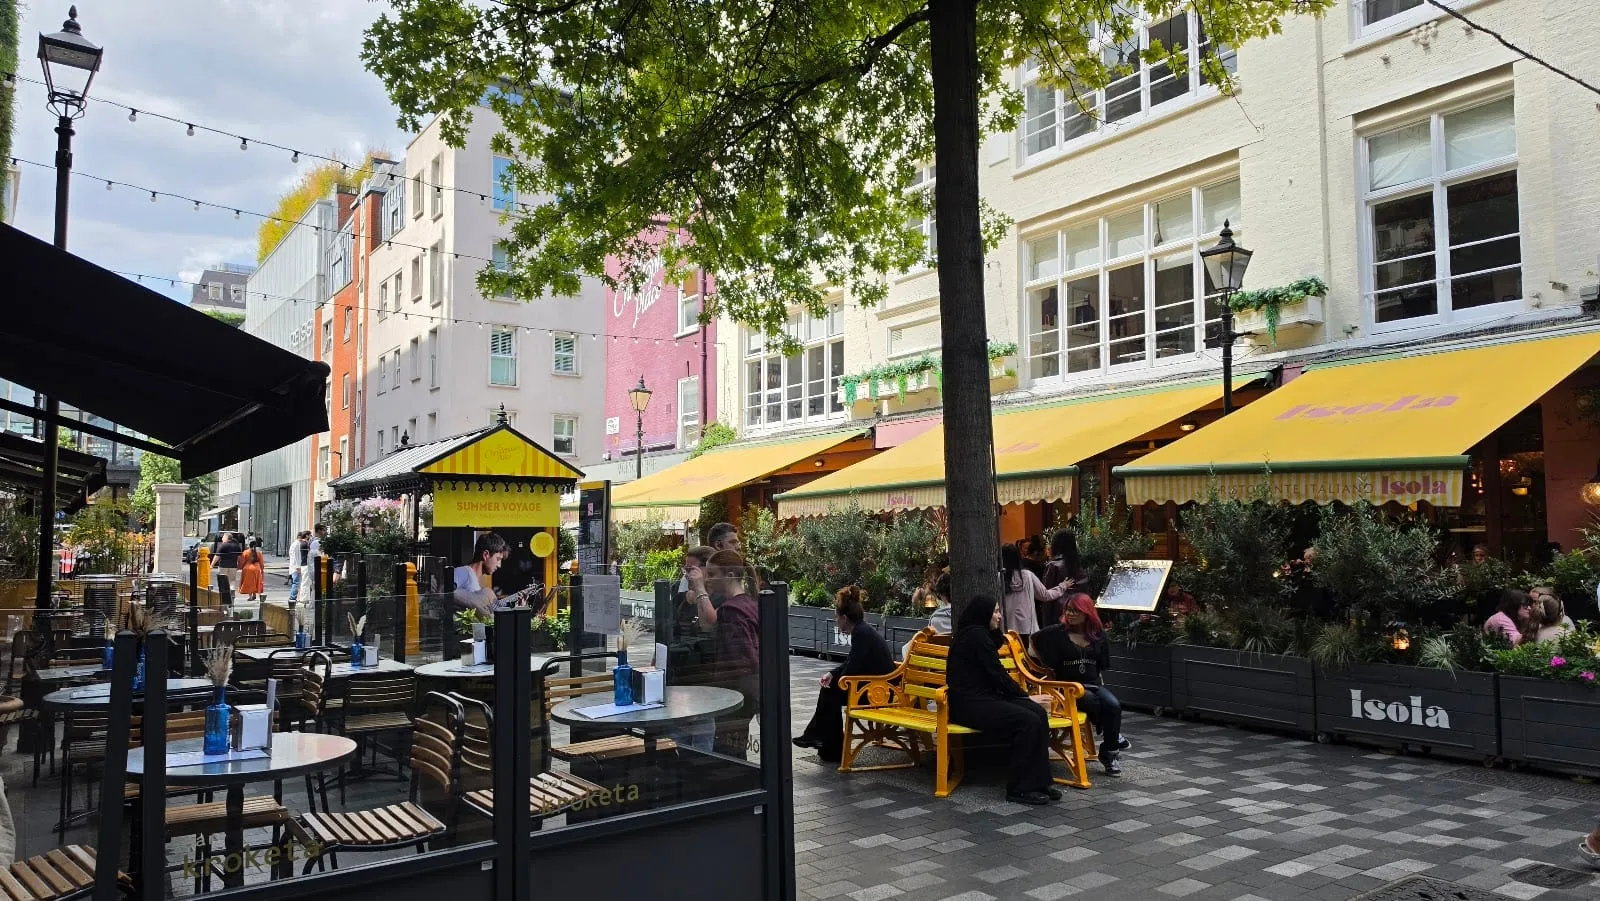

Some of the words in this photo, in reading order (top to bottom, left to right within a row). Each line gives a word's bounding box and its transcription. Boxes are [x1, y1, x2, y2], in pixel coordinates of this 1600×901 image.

[1273, 394, 1460, 422] Isola
[1381, 475, 1447, 495] Isola
[456, 501, 500, 512] SUMMER
[502, 502, 541, 512] VOYAGE
[888, 494, 914, 505] Isola
[631, 602, 653, 619] Isola
[1349, 689, 1451, 729] Isola
[541, 783, 639, 815] kroketa
[183, 837, 324, 880] kroketa
